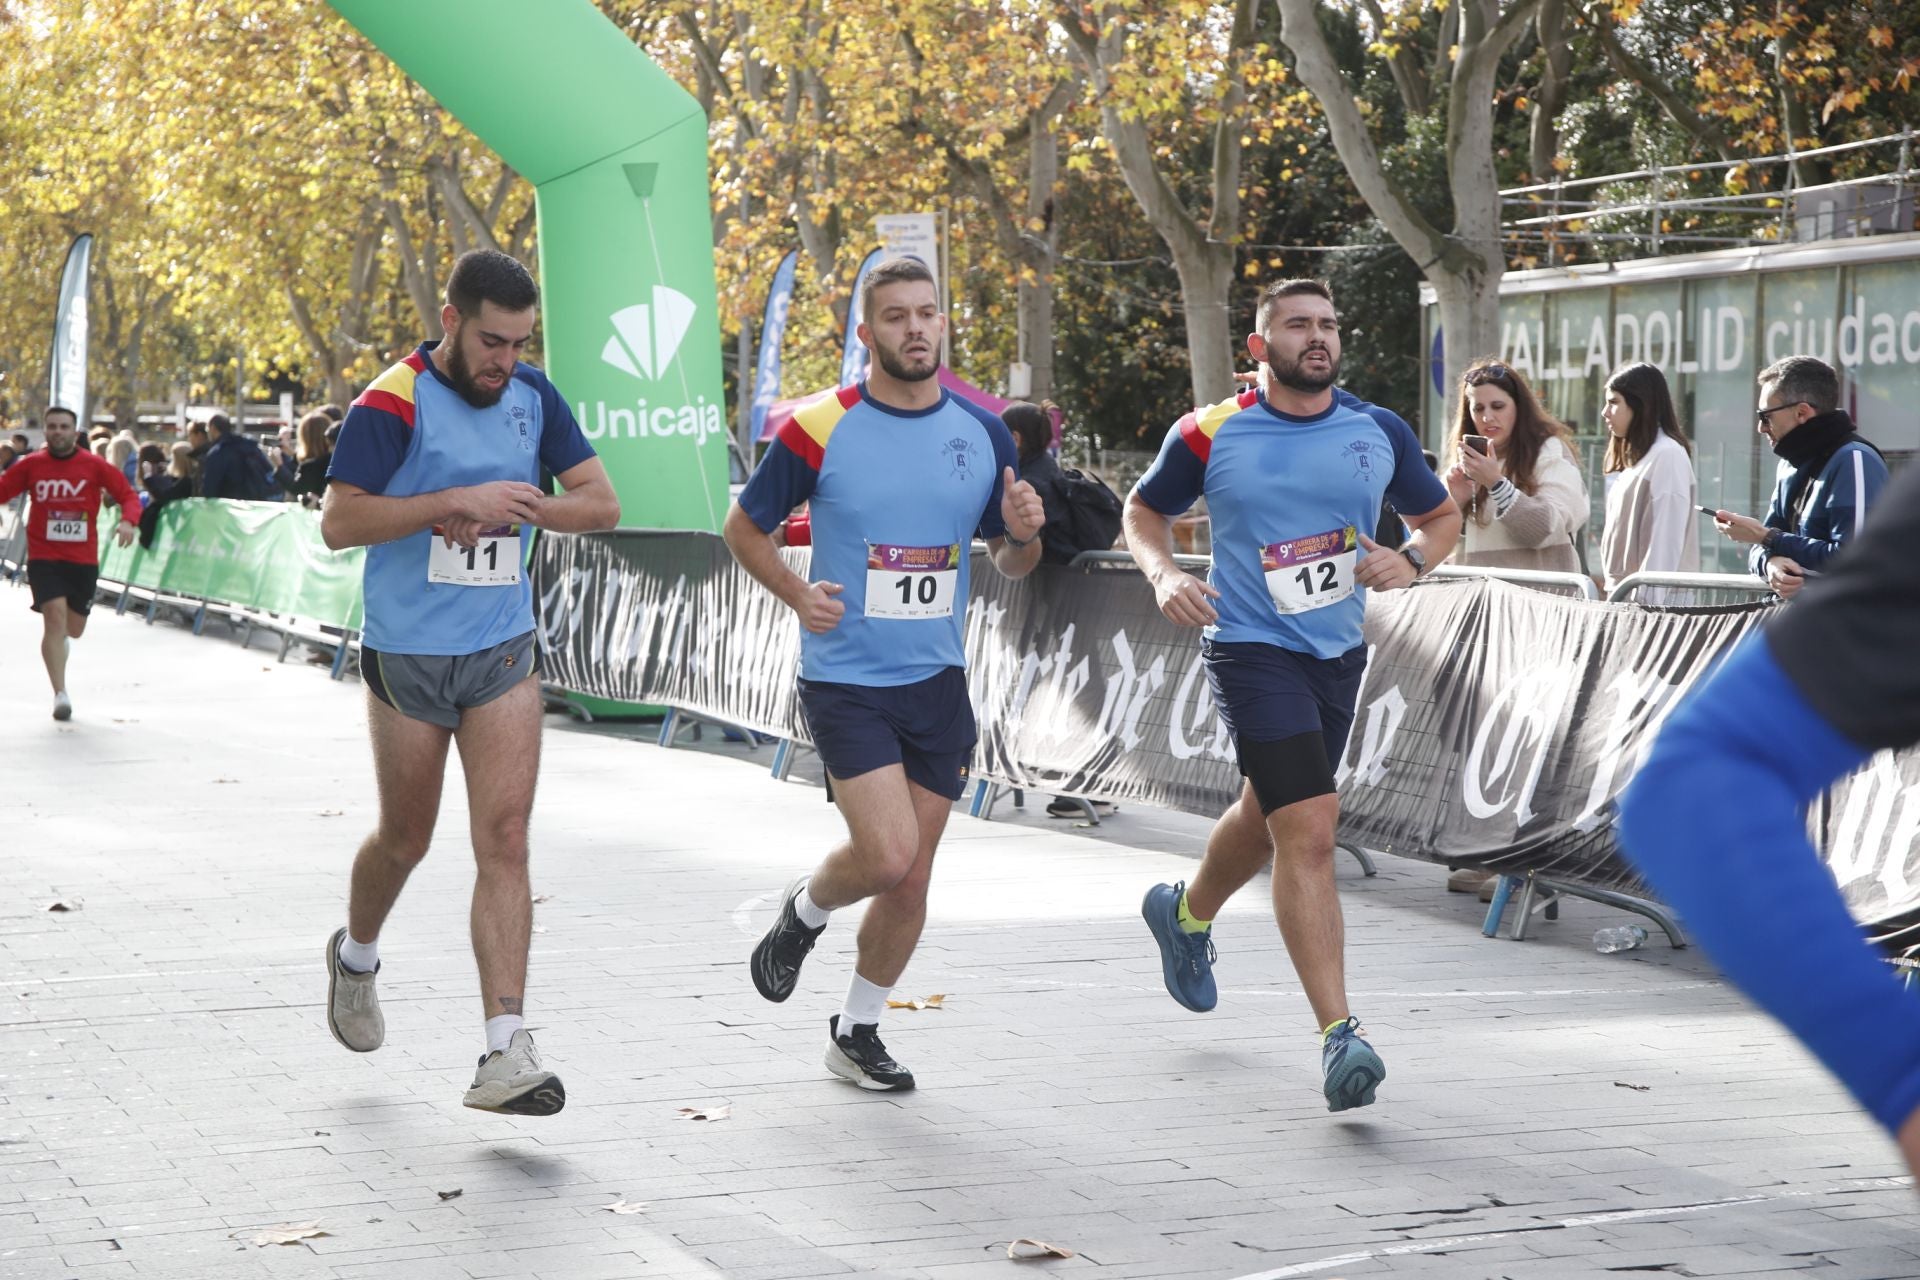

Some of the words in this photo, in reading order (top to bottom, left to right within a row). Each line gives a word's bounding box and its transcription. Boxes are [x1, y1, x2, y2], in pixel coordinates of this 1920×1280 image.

[578, 395, 721, 446] Unicaja
[36, 479, 87, 502] gmv
[53, 522, 81, 535] 402
[460, 540, 498, 571] 11
[902, 555, 937, 563] EMPRESAS
[1294, 542, 1330, 556] EMPRESAS
[895, 575, 937, 605] 10
[1295, 561, 1339, 596] 12
[1095, 627, 1165, 752] de
